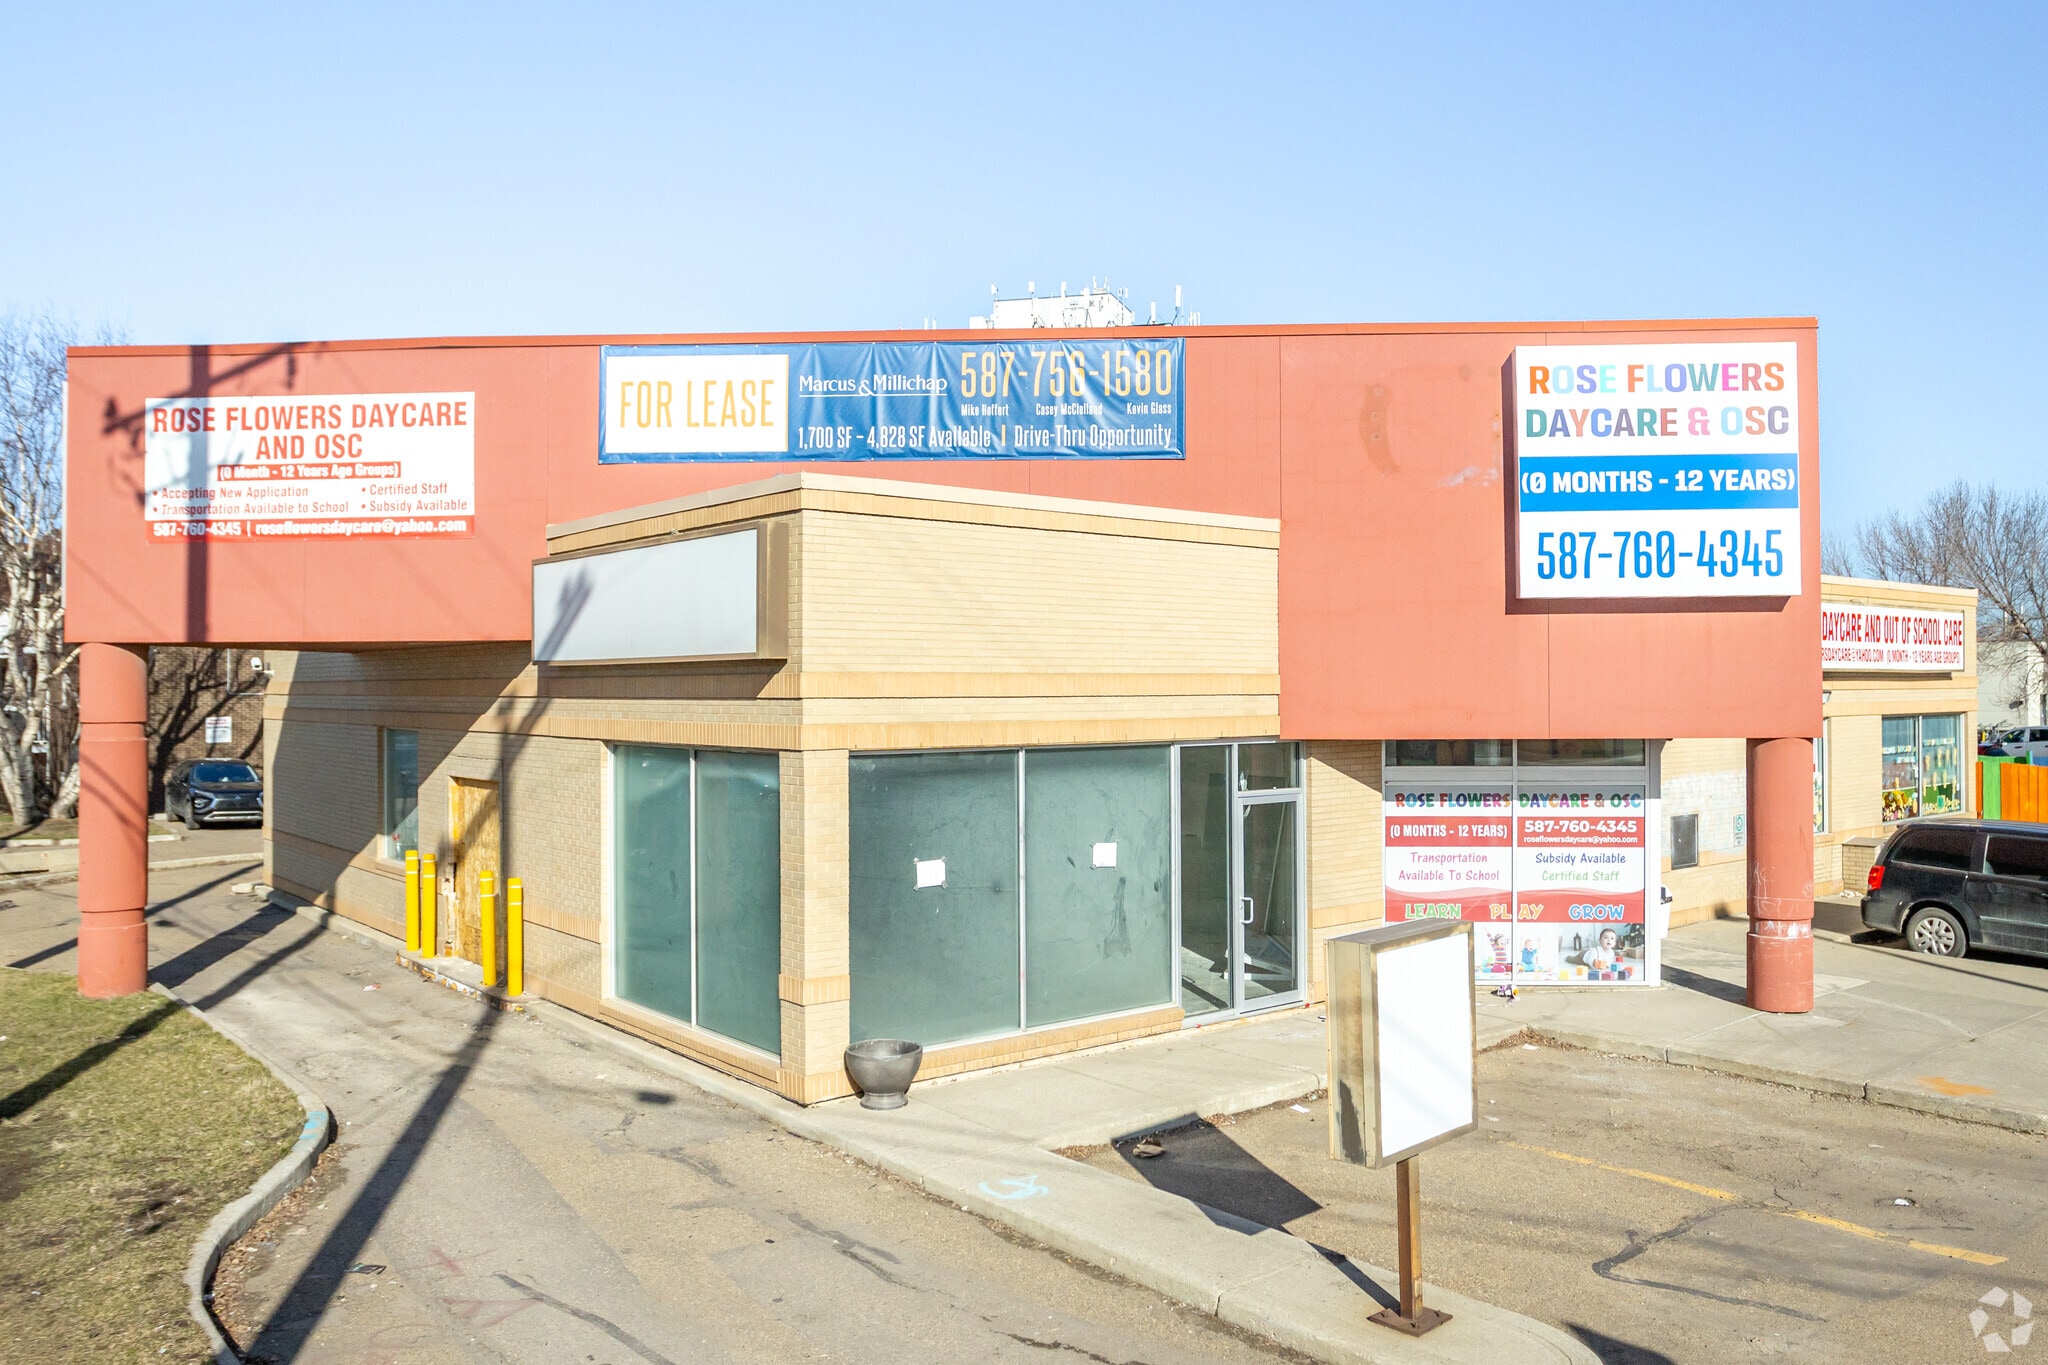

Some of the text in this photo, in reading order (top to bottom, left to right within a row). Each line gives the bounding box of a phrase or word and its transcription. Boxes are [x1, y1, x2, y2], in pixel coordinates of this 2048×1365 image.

[961, 349, 1172, 398] 587-756-1580
[1529, 362, 1785, 394] ROSE FLOWERS
[800, 374, 948, 396] Marcus & Millichap
[620, 380, 774, 428] FOR LEASE
[961, 404, 980, 416] Mike
[1036, 403, 1058, 417] Casey
[1127, 402, 1172, 415] Kevin Glass
[152, 401, 467, 432] ROSE FLOWERS DAYCARE
[1526, 405, 1789, 438] DAYCARE & OSC
[799, 426, 833, 450] 1,700
[837, 426, 853, 448] SF
[867, 425, 906, 448] 4,828
[910, 425, 925, 448] SF
[929, 425, 991, 448] Available
[1014, 424, 1087, 447] Drive-Thru
[1090, 423, 1172, 449] Opportunity
[256, 433, 363, 460] AND OSC
[234, 465, 269, 479] Month
[281, 465, 295, 478] 12
[297, 464, 329, 478] Years
[331, 464, 352, 479] Age
[355, 463, 399, 478] Groups)
[1553, 470, 1652, 493] MONTHS
[1675, 469, 1703, 492] 12
[1709, 468, 1795, 492] YEARS)
[162, 486, 309, 500] Accepting New Application
[370, 482, 448, 496] Certified Staff
[162, 501, 349, 517] Transportation Available to School
[370, 499, 467, 513] Subsidy Available
[153, 521, 241, 537] 587-760-4345
[255, 518, 467, 537] roseflowersdaycare@yahoo.com
[1537, 529, 1783, 580] 587-760-4345
[1822, 611, 1962, 646] DAYCARE AND OUT OF SCHOOL CARE
[1395, 792, 1641, 808] ROSE FLOWERS DAYCARE & OSC
[1403, 824, 1447, 837] MONTHS
[1458, 824, 1469, 837] 12
[1471, 824, 1508, 839] YEARS)
[1524, 819, 1637, 834] 587-760-4345
[1524, 835, 1638, 845] roseflowersdaycare@yahoo.com
[1410, 852, 1488, 865] Transportation
[1535, 853, 1626, 866] Subsidy Available
[1399, 870, 1500, 882] Available To School
[1542, 870, 1620, 881] Certified Staff
[1405, 903, 1462, 920] LEARN
[1490, 903, 1544, 920] PLAY
[1568, 904, 1625, 920] GROW
